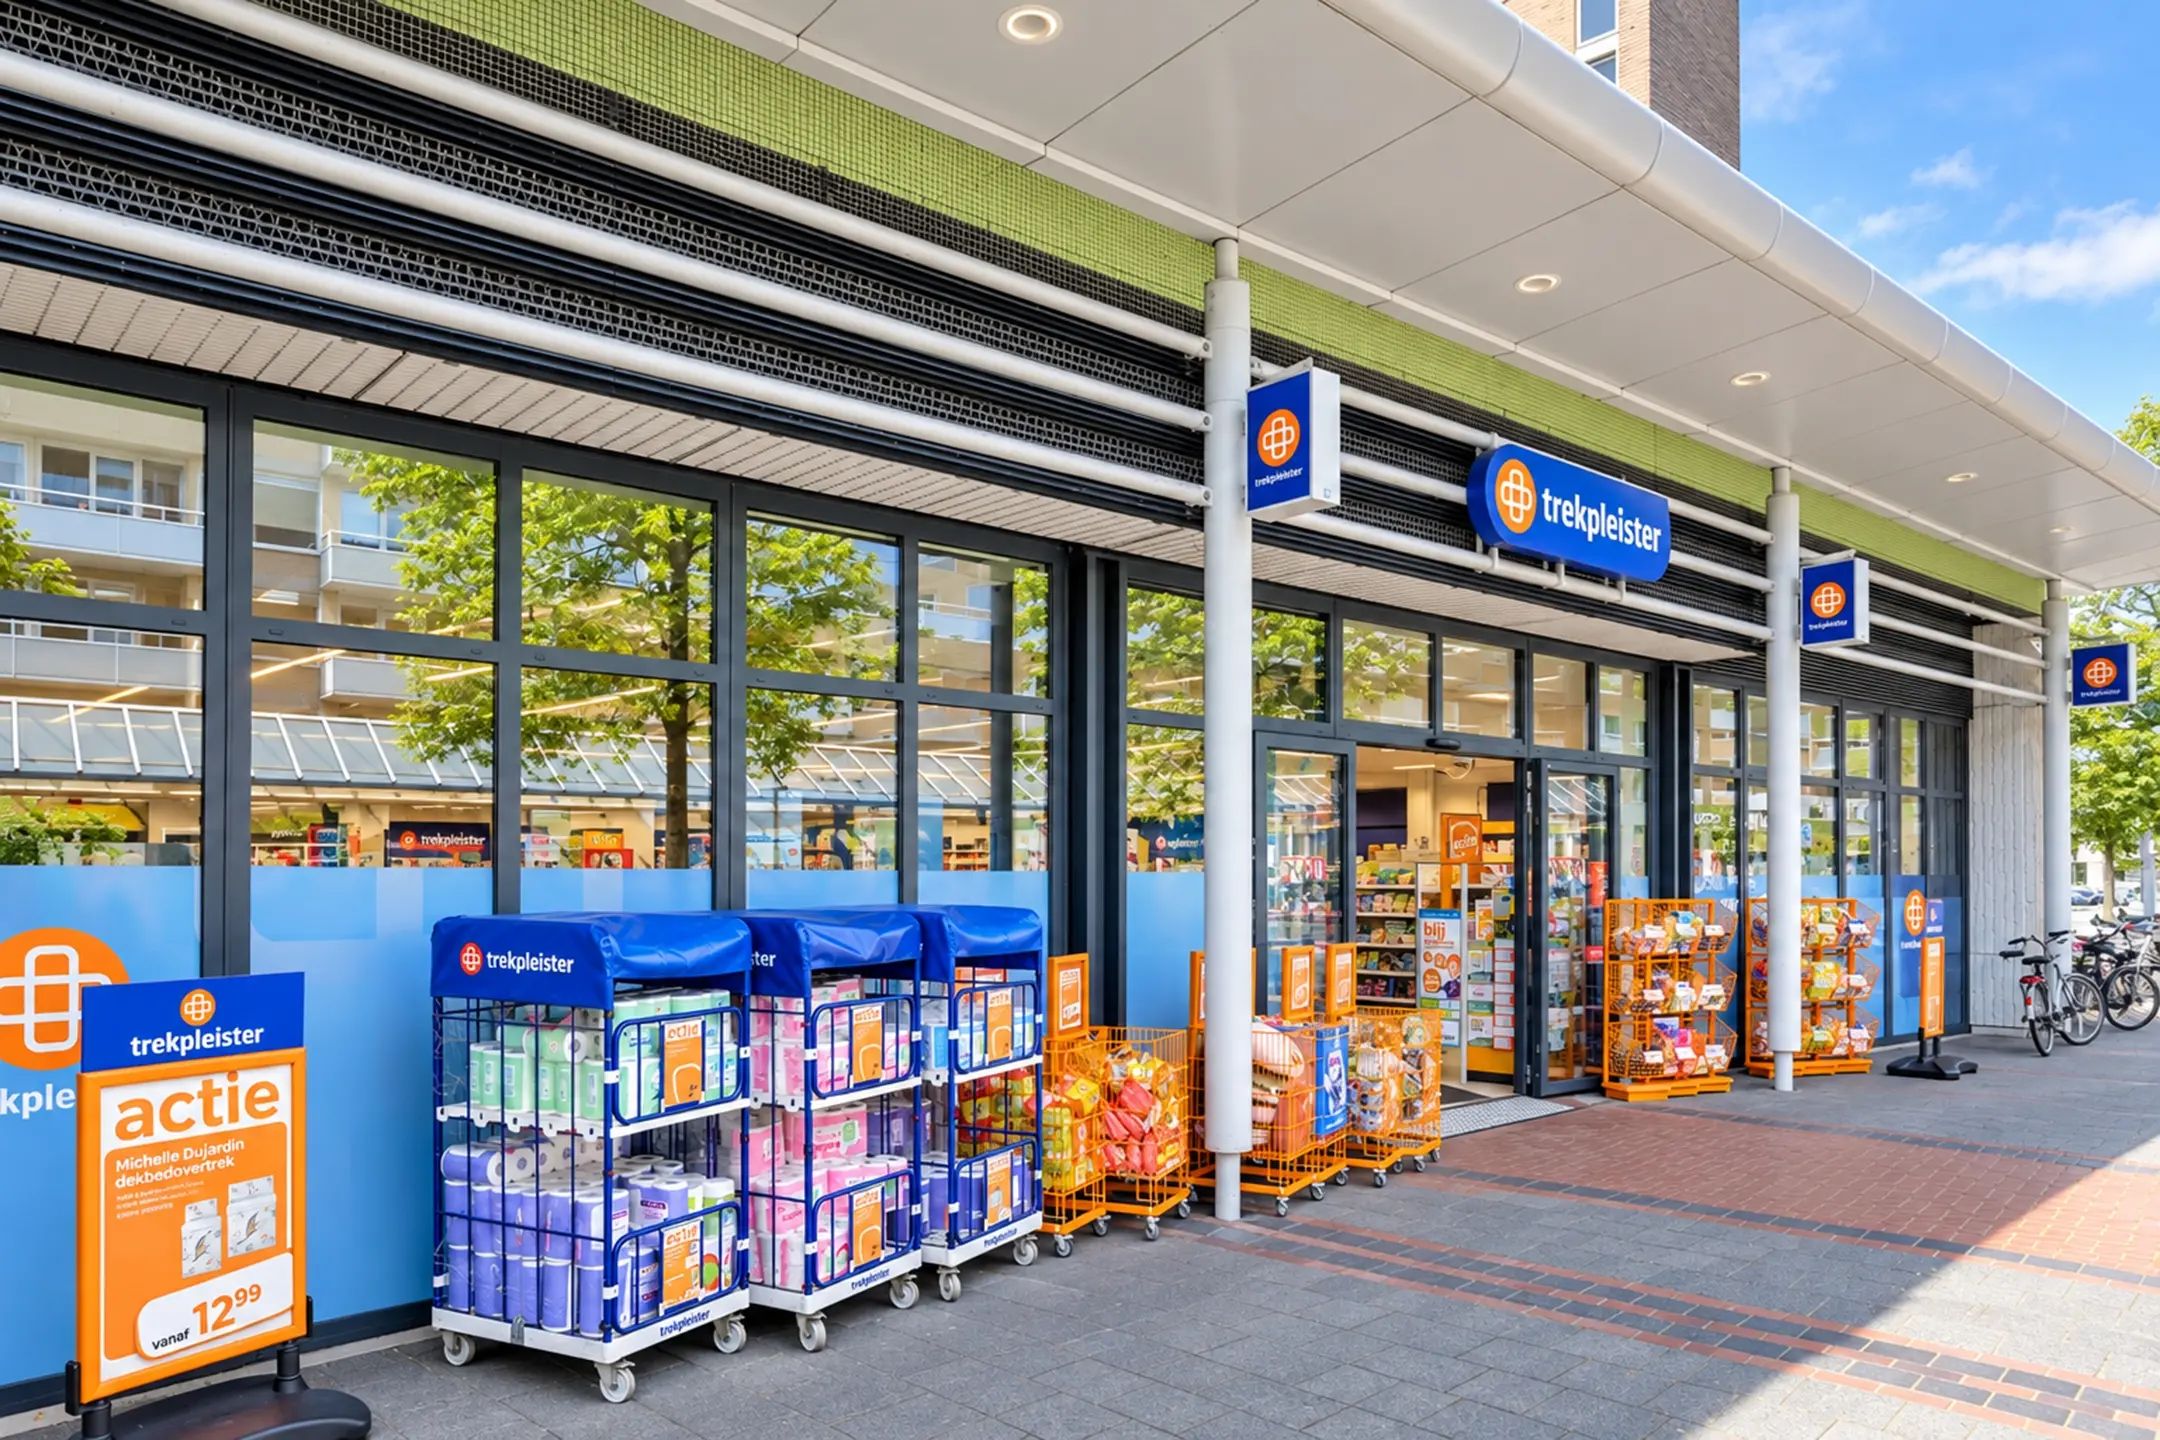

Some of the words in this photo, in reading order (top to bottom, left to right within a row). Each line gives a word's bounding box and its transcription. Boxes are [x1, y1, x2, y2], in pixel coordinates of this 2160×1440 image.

[1541, 486, 1662, 554] trekpleister
[486, 951, 575, 974] trekpleister
[130, 1027, 264, 1057] trekpleister
[114, 1071, 280, 1141] actie
[115, 1151, 179, 1173] Michelle
[183, 1138, 245, 1161] Dujardin
[115, 1155, 235, 1189] dekbedovertrek
[151, 1329, 190, 1351] vanaf
